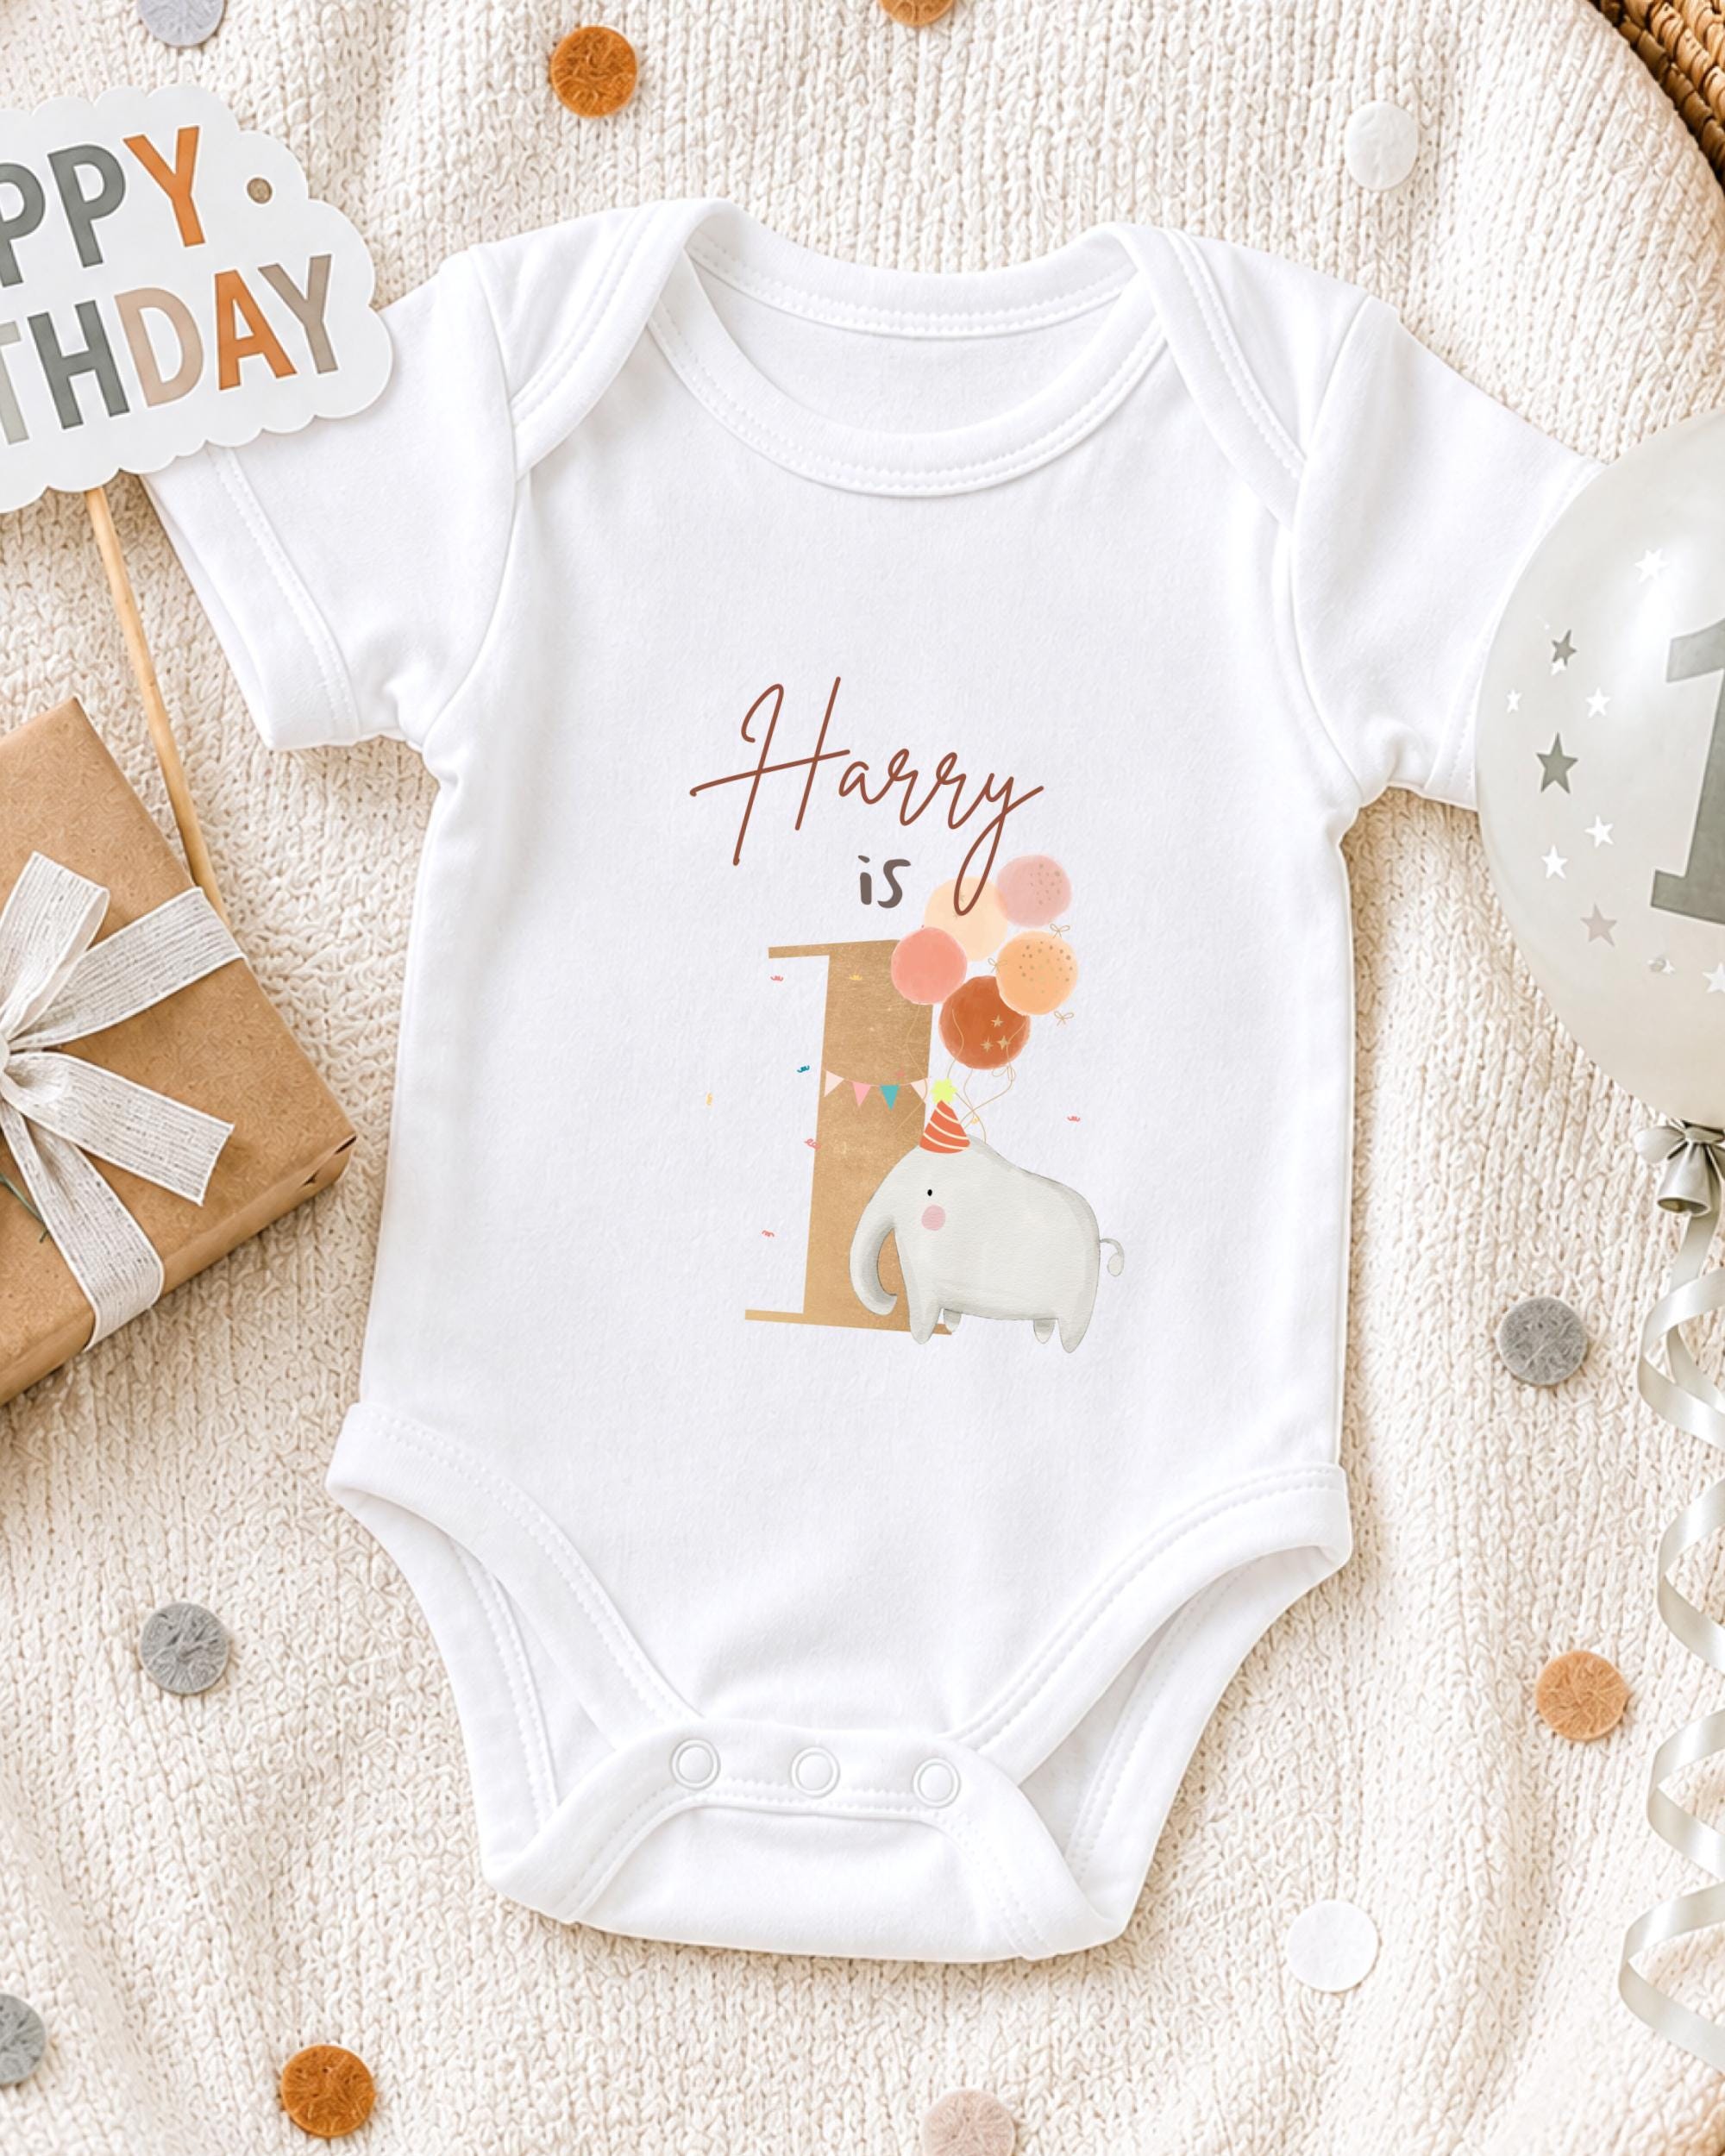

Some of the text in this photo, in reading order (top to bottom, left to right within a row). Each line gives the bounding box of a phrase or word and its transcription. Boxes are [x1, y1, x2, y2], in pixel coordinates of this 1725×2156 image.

[689, 676, 1044, 916] Harry
[857, 856, 912, 910] is
[744, 939, 954, 1336] 1
